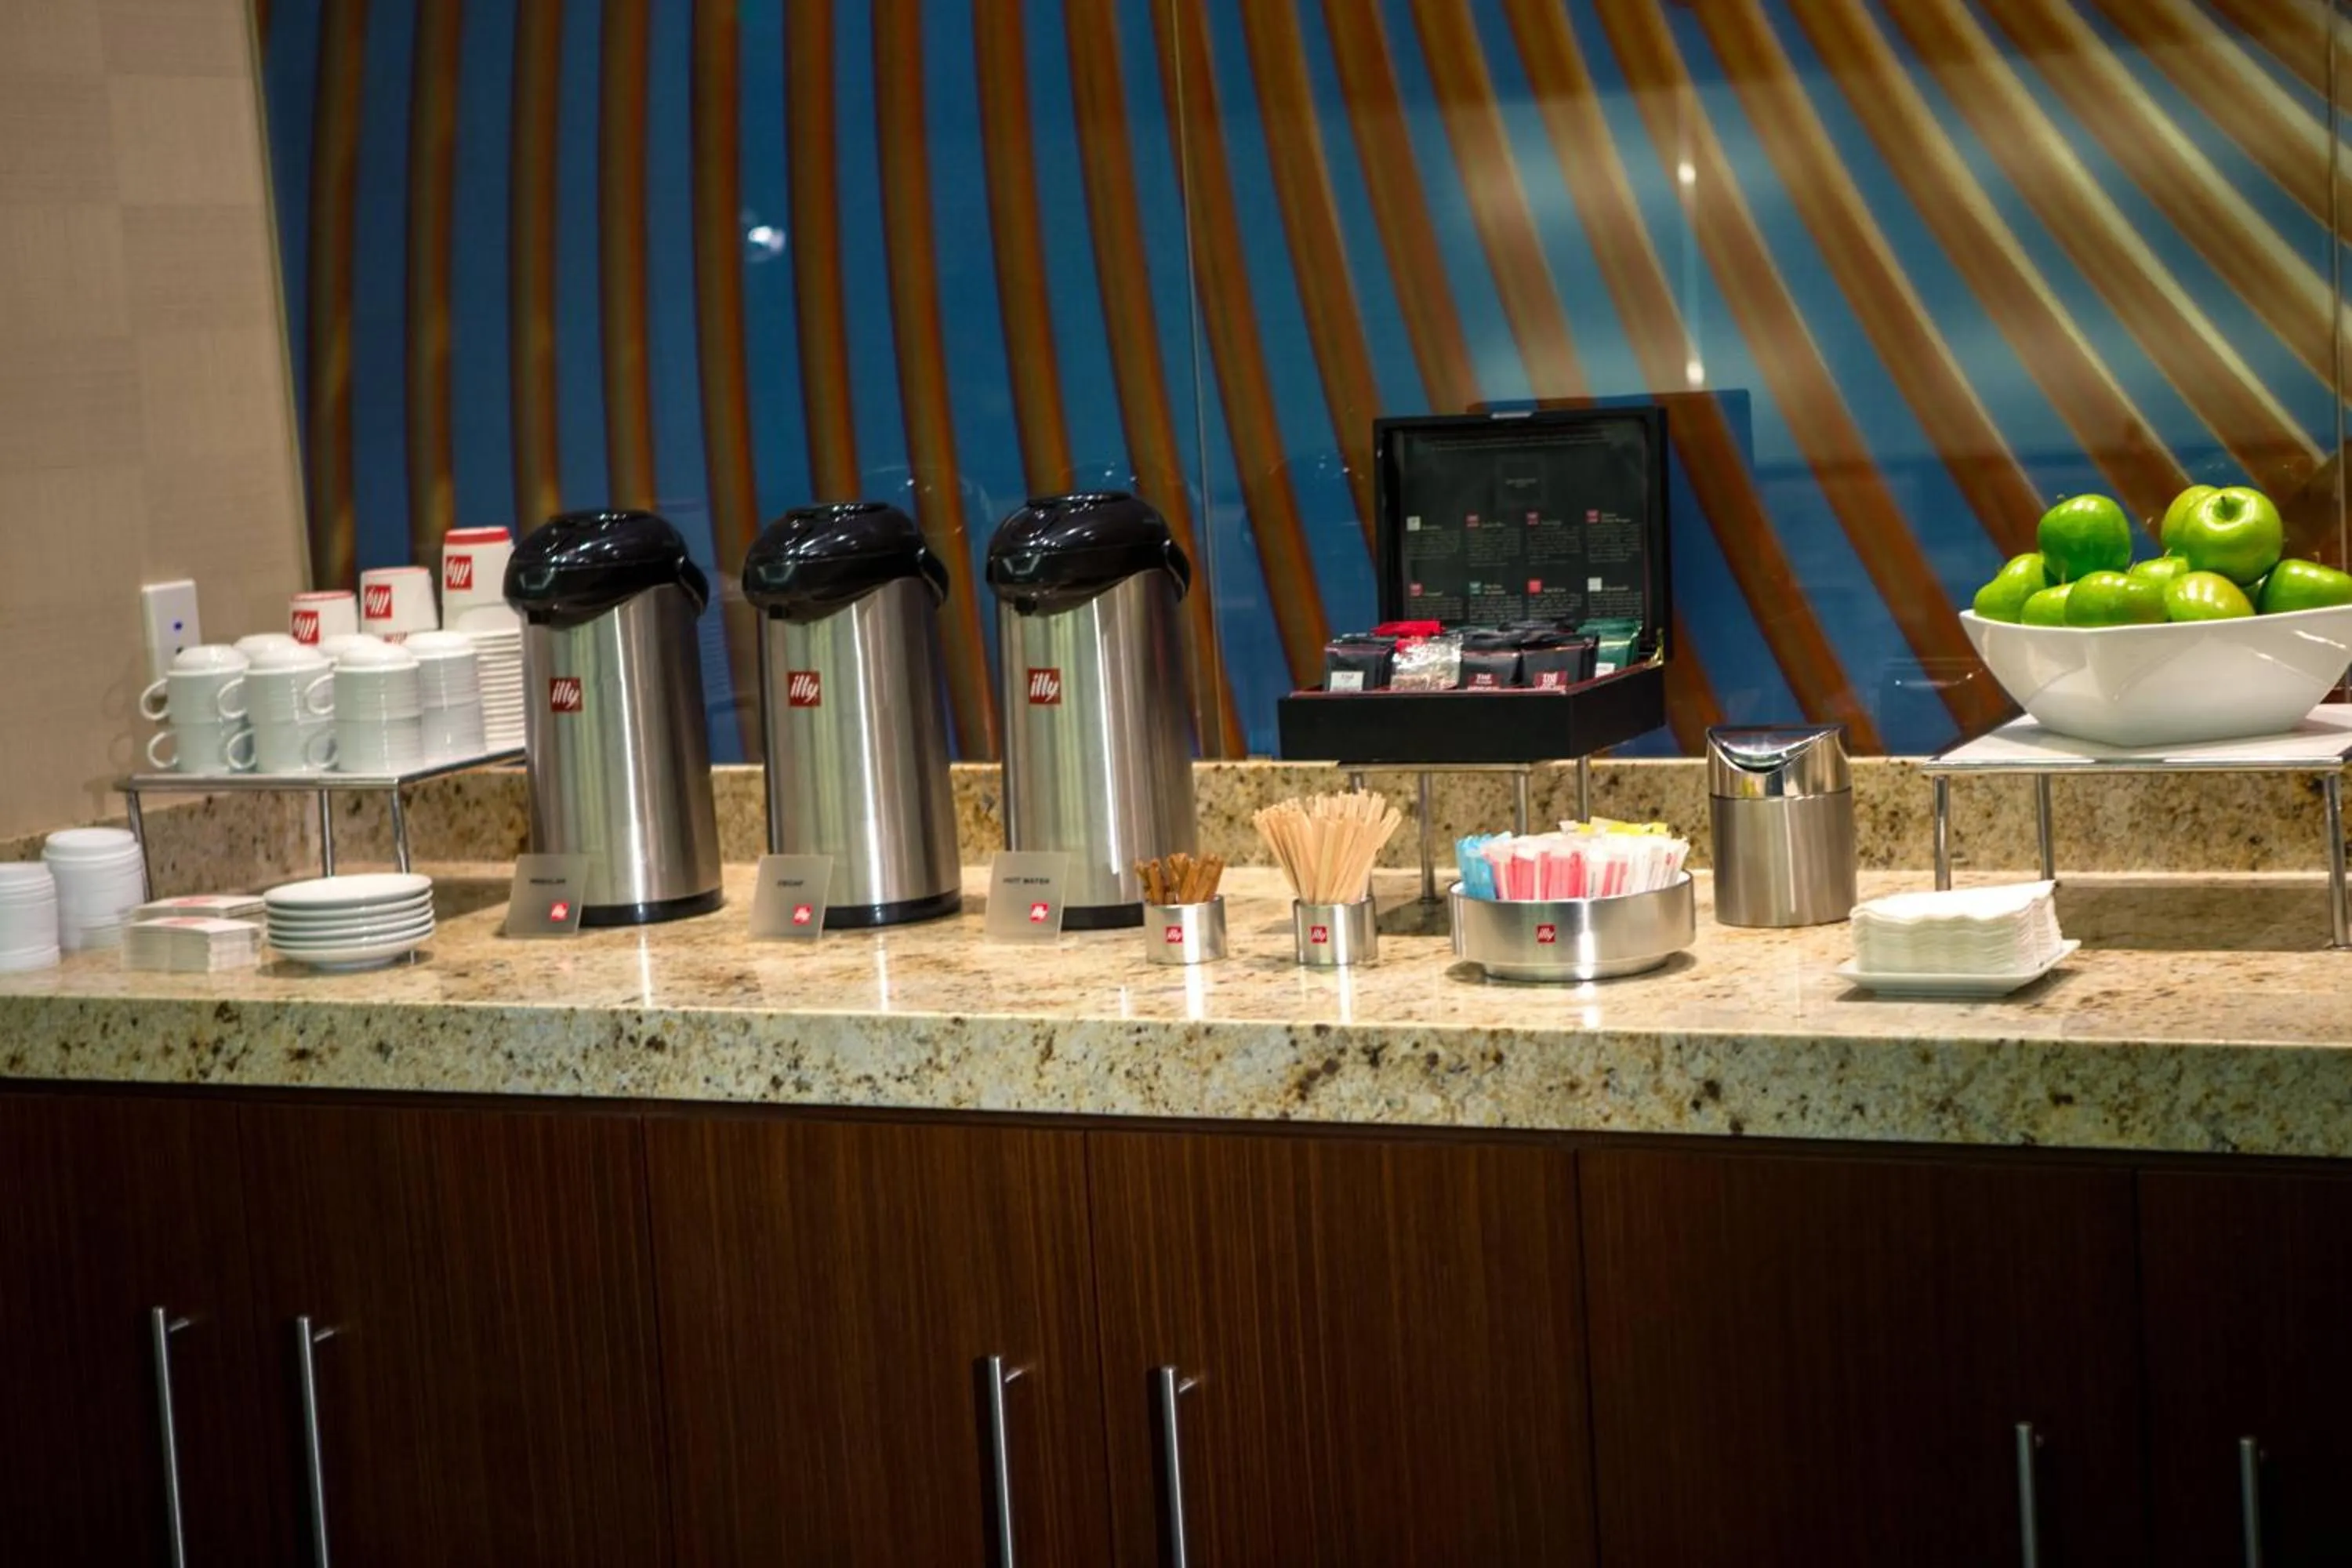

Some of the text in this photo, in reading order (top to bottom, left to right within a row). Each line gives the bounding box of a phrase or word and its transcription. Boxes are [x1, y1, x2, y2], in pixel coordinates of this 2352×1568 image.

[551, 681, 581, 710] illy
[789, 674, 819, 703] illy
[1029, 671, 1059, 702] illy
